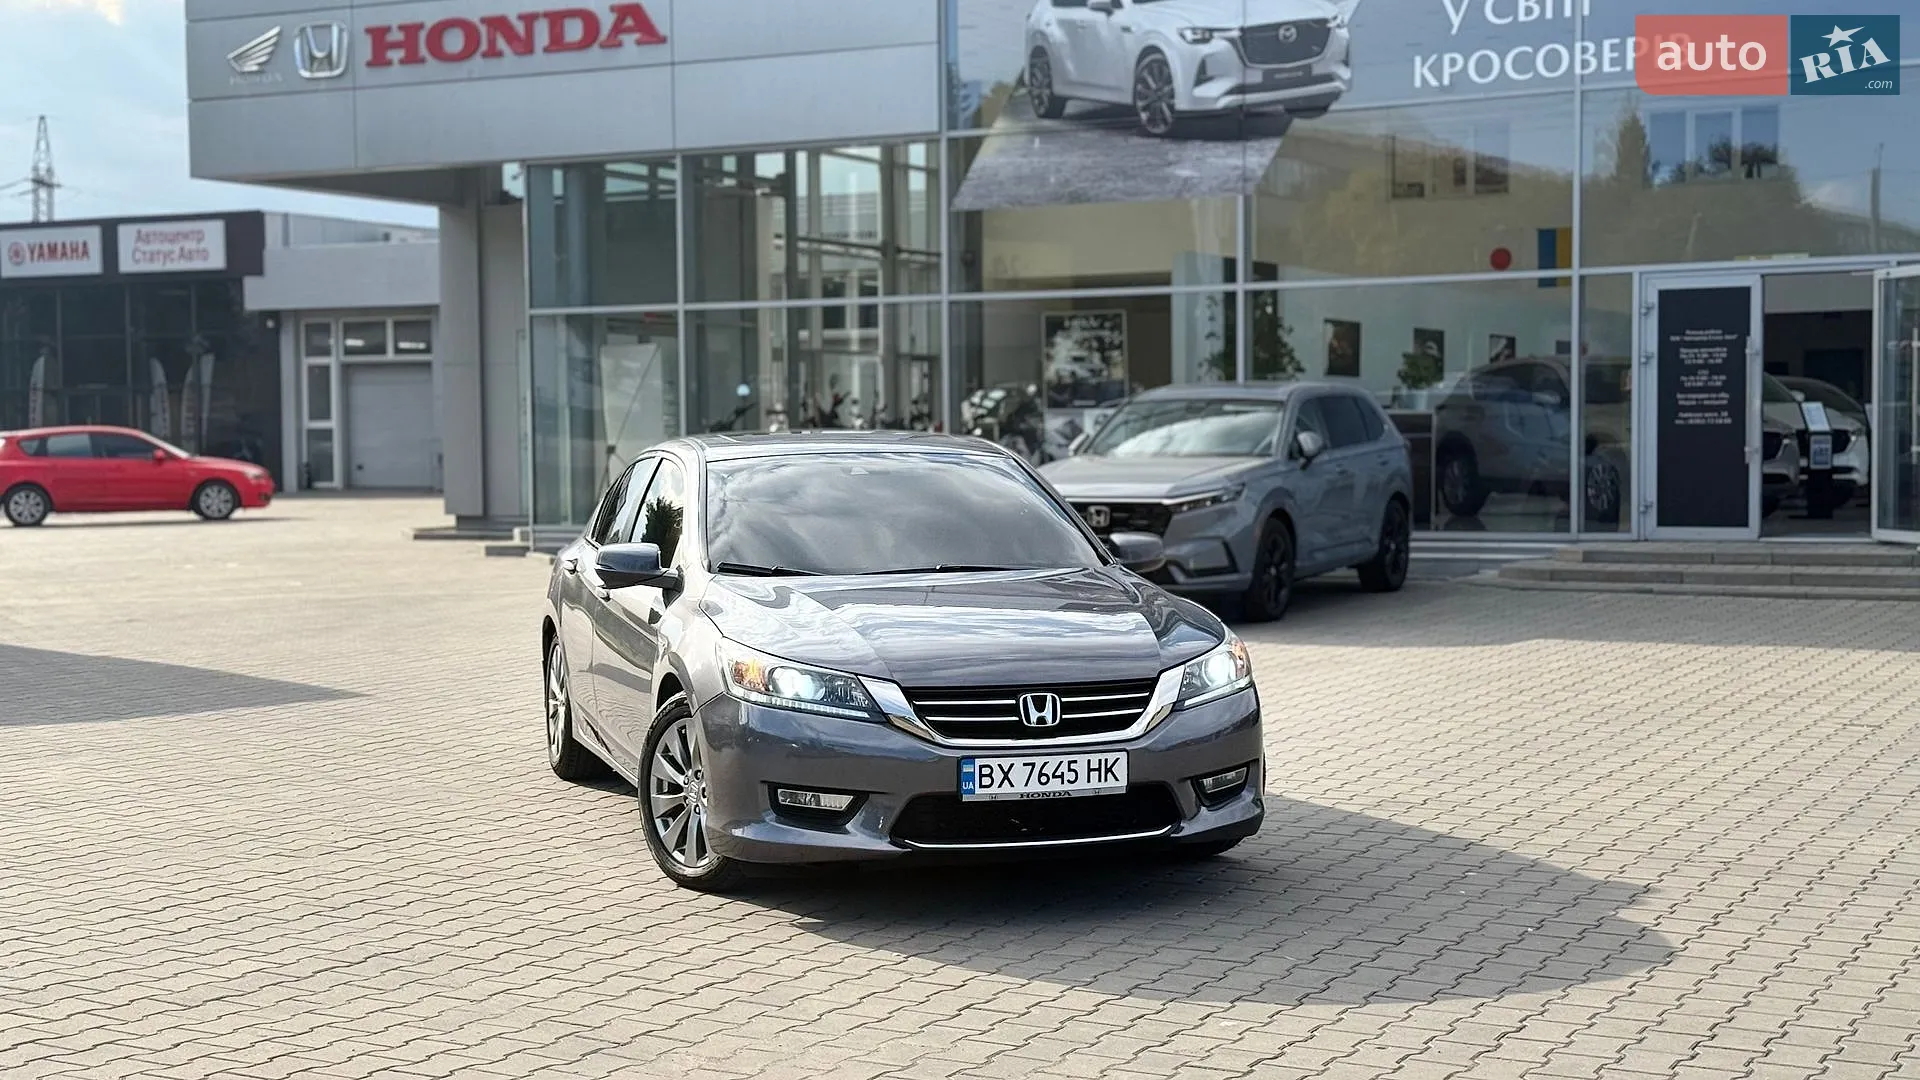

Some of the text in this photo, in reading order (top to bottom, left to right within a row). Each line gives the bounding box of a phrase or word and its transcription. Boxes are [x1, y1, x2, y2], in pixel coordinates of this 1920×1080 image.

[365, 3, 667, 68] HONDA
[135, 229, 205, 246] Автоцентр
[27, 240, 90, 262] YAMAHA
[132, 247, 209, 266] Статус Авто
[978, 757, 1121, 789] BX 7645 HK
[962, 781, 974, 790] UA
[1019, 791, 1072, 799] HONDA
